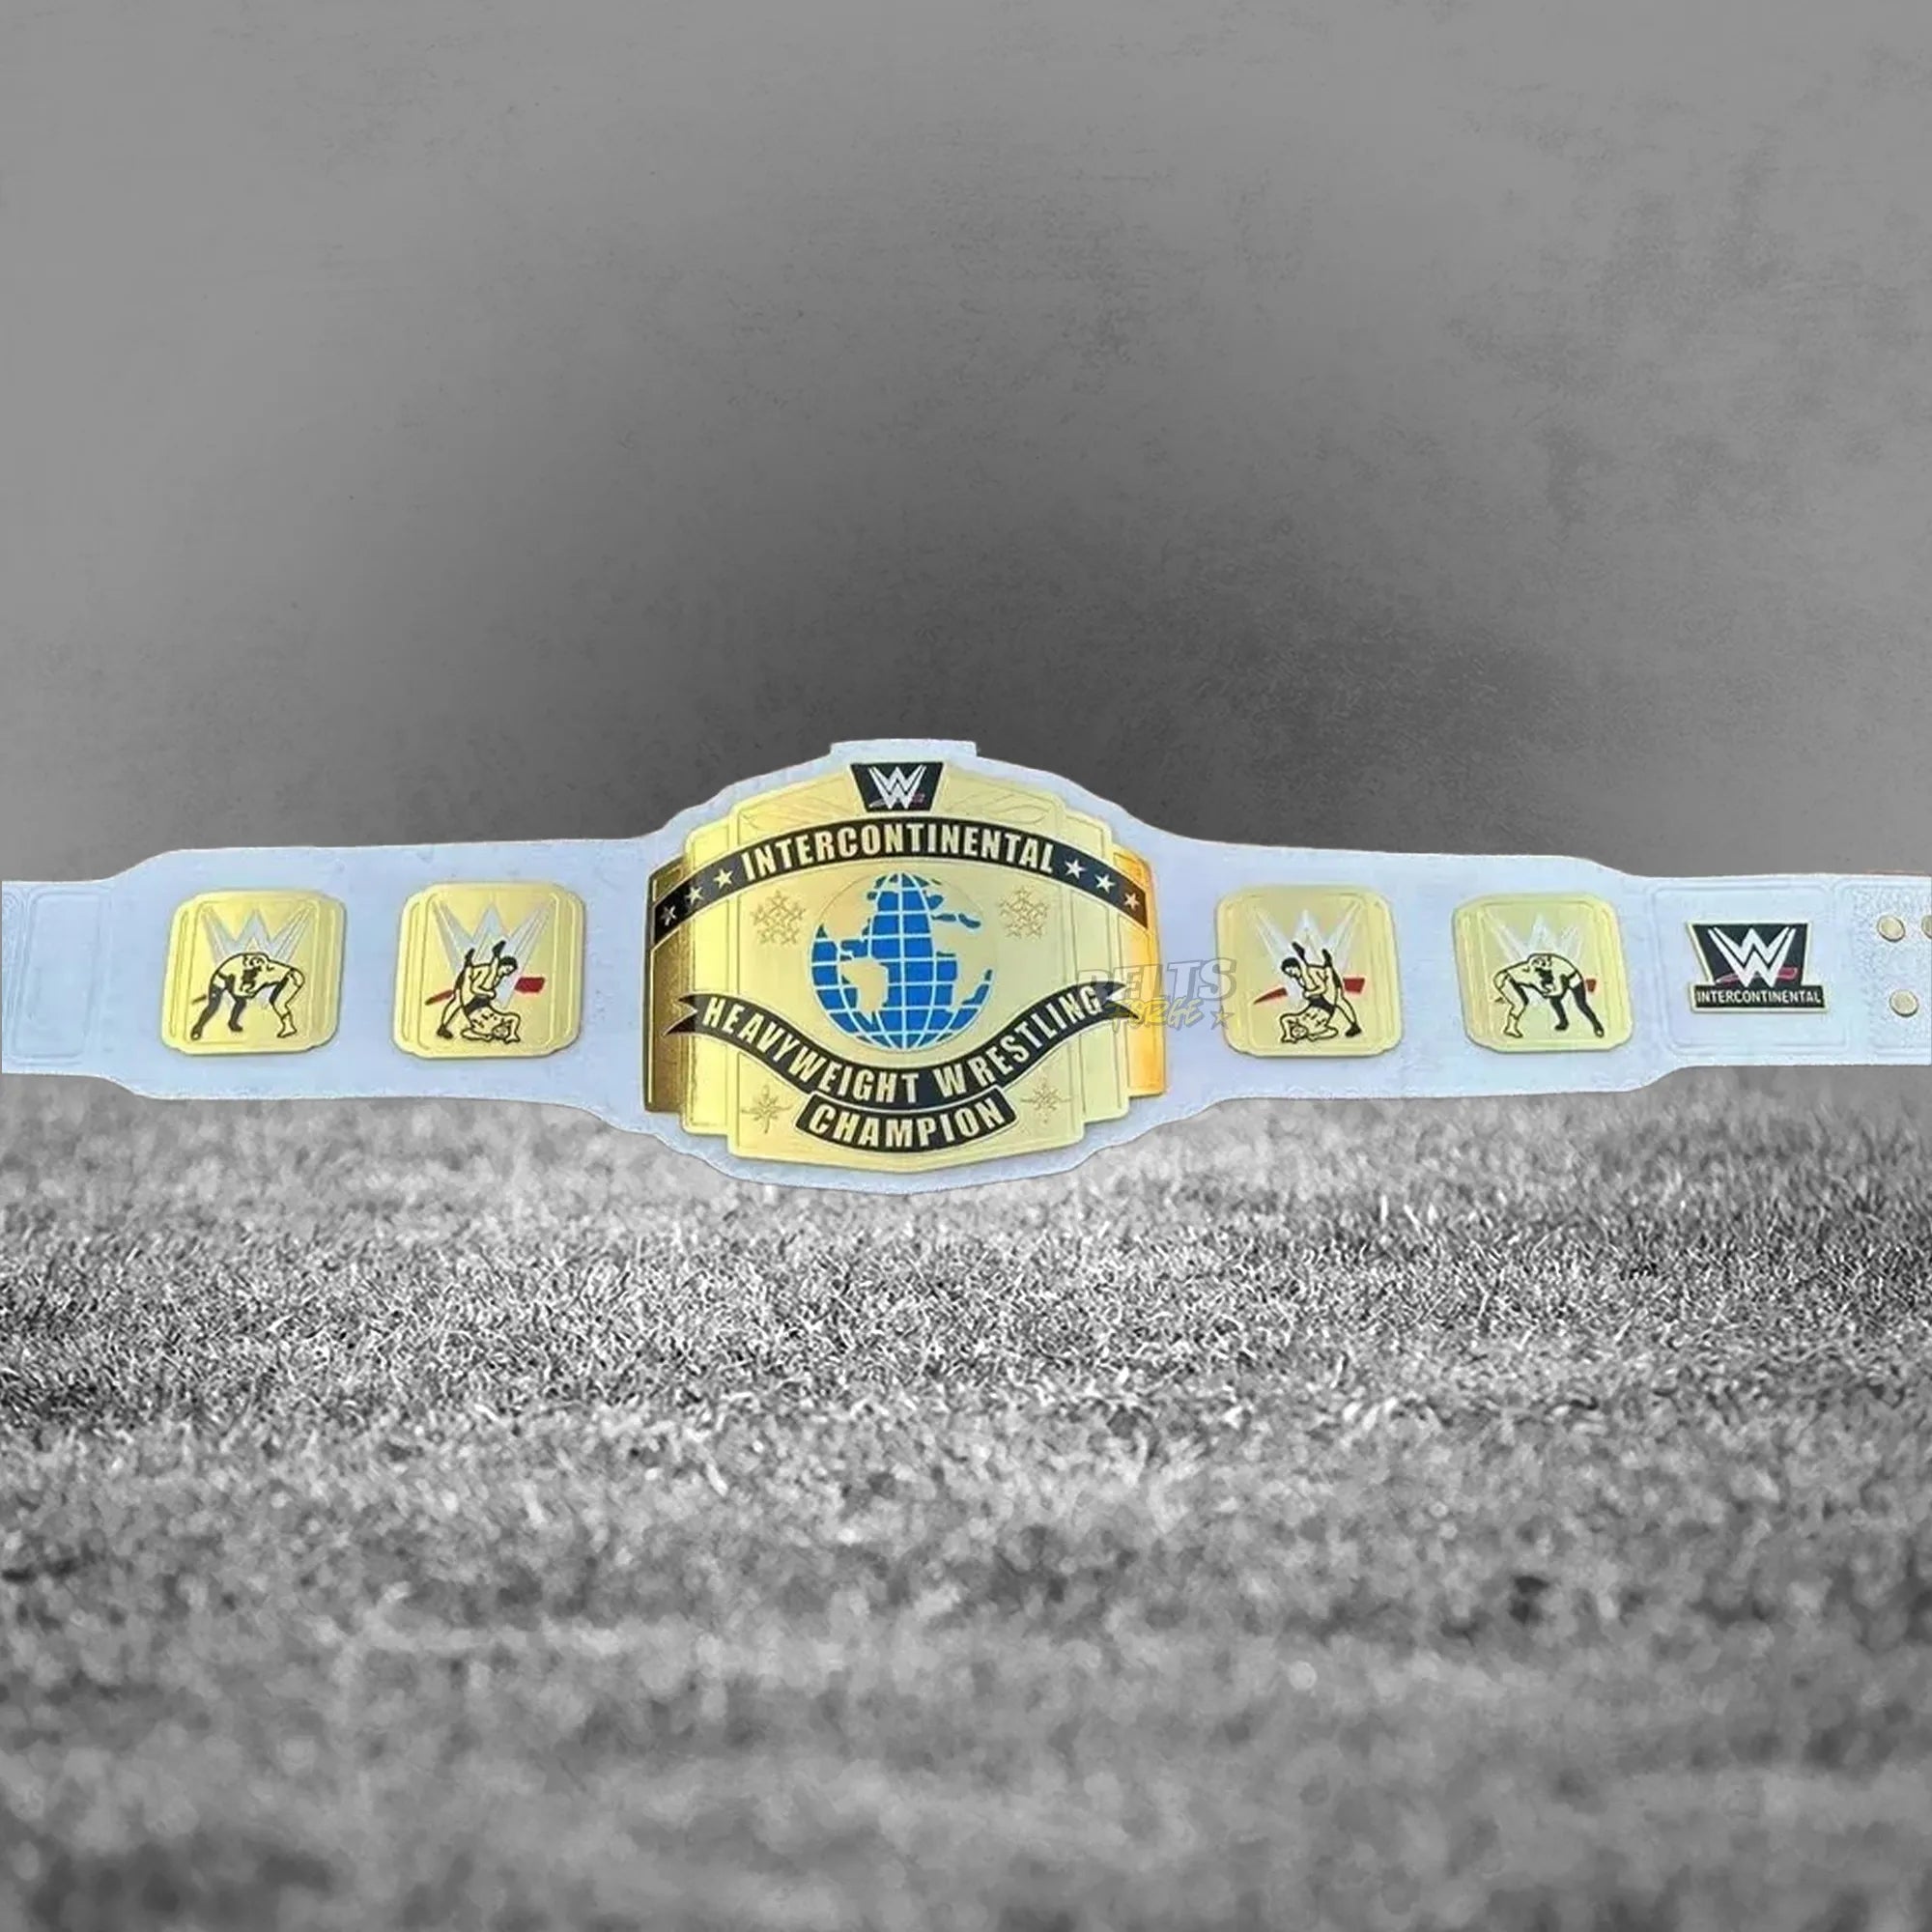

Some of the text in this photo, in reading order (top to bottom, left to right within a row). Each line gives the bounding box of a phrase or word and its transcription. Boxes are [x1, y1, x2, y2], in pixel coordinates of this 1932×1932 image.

[741, 823, 1054, 881] INTERCONTINENTAL
[1696, 988, 1822, 1004] INTERCONTINENTAL
[702, 985, 1103, 1104] HEAVYWEIGHT WRESTLING
[809, 1097, 1006, 1148] CHAMPION
